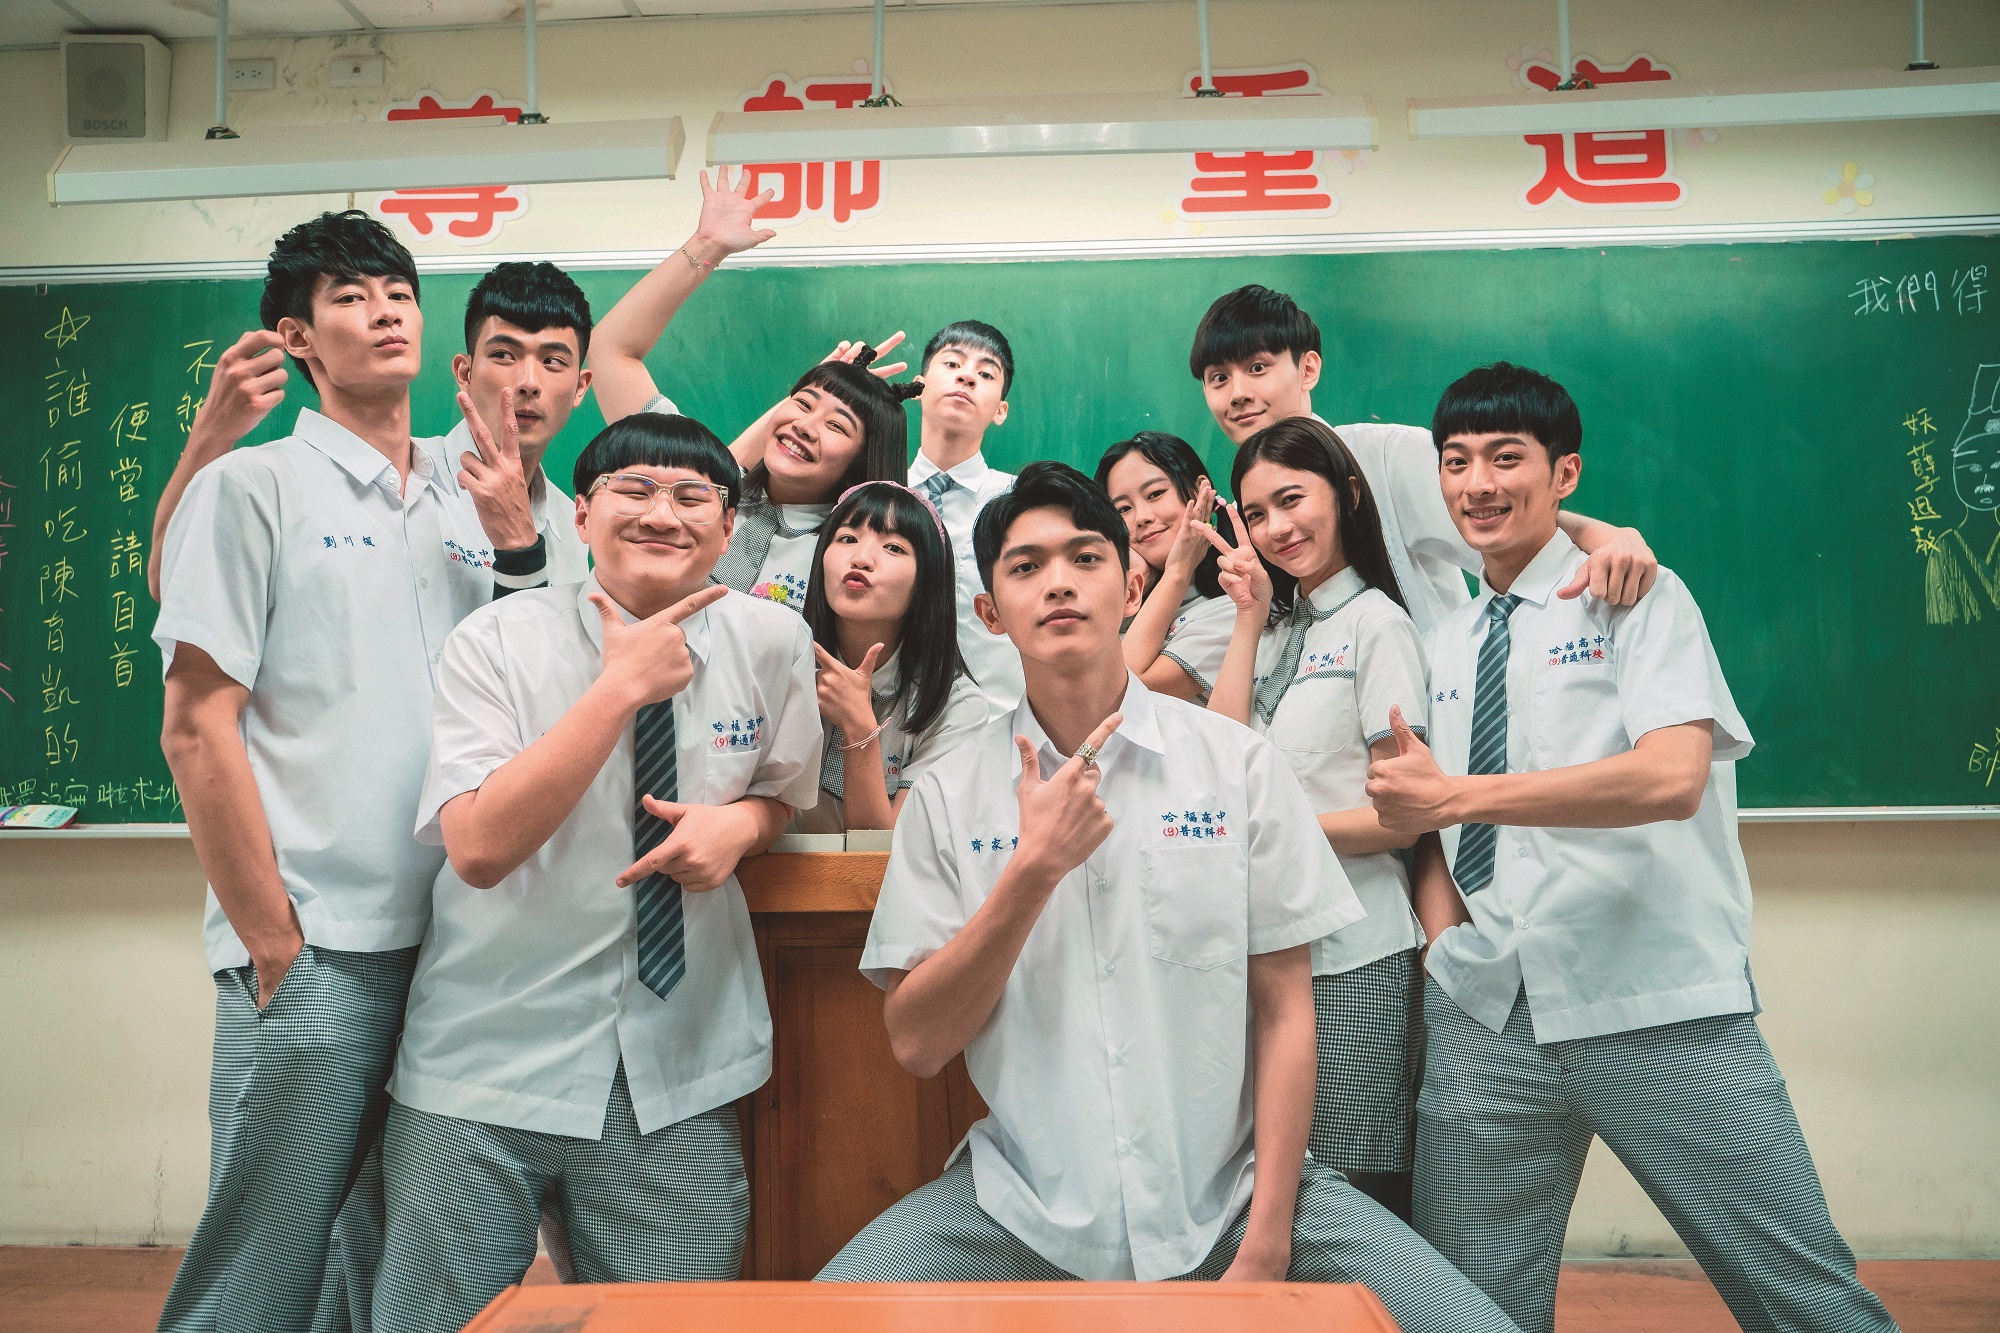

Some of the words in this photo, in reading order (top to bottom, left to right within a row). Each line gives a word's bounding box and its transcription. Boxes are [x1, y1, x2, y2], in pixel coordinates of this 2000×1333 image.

[83, 120, 128, 130] BOSCH
[1848, 265, 1988, 316] 我們得
[39, 357, 91, 764] 誰偷吃陳育凱的
[1548, 634, 1605, 655] 哈福高中
[712, 715, 764, 733] 哈福高中
[1161, 810, 1226, 824] 哈福高中
